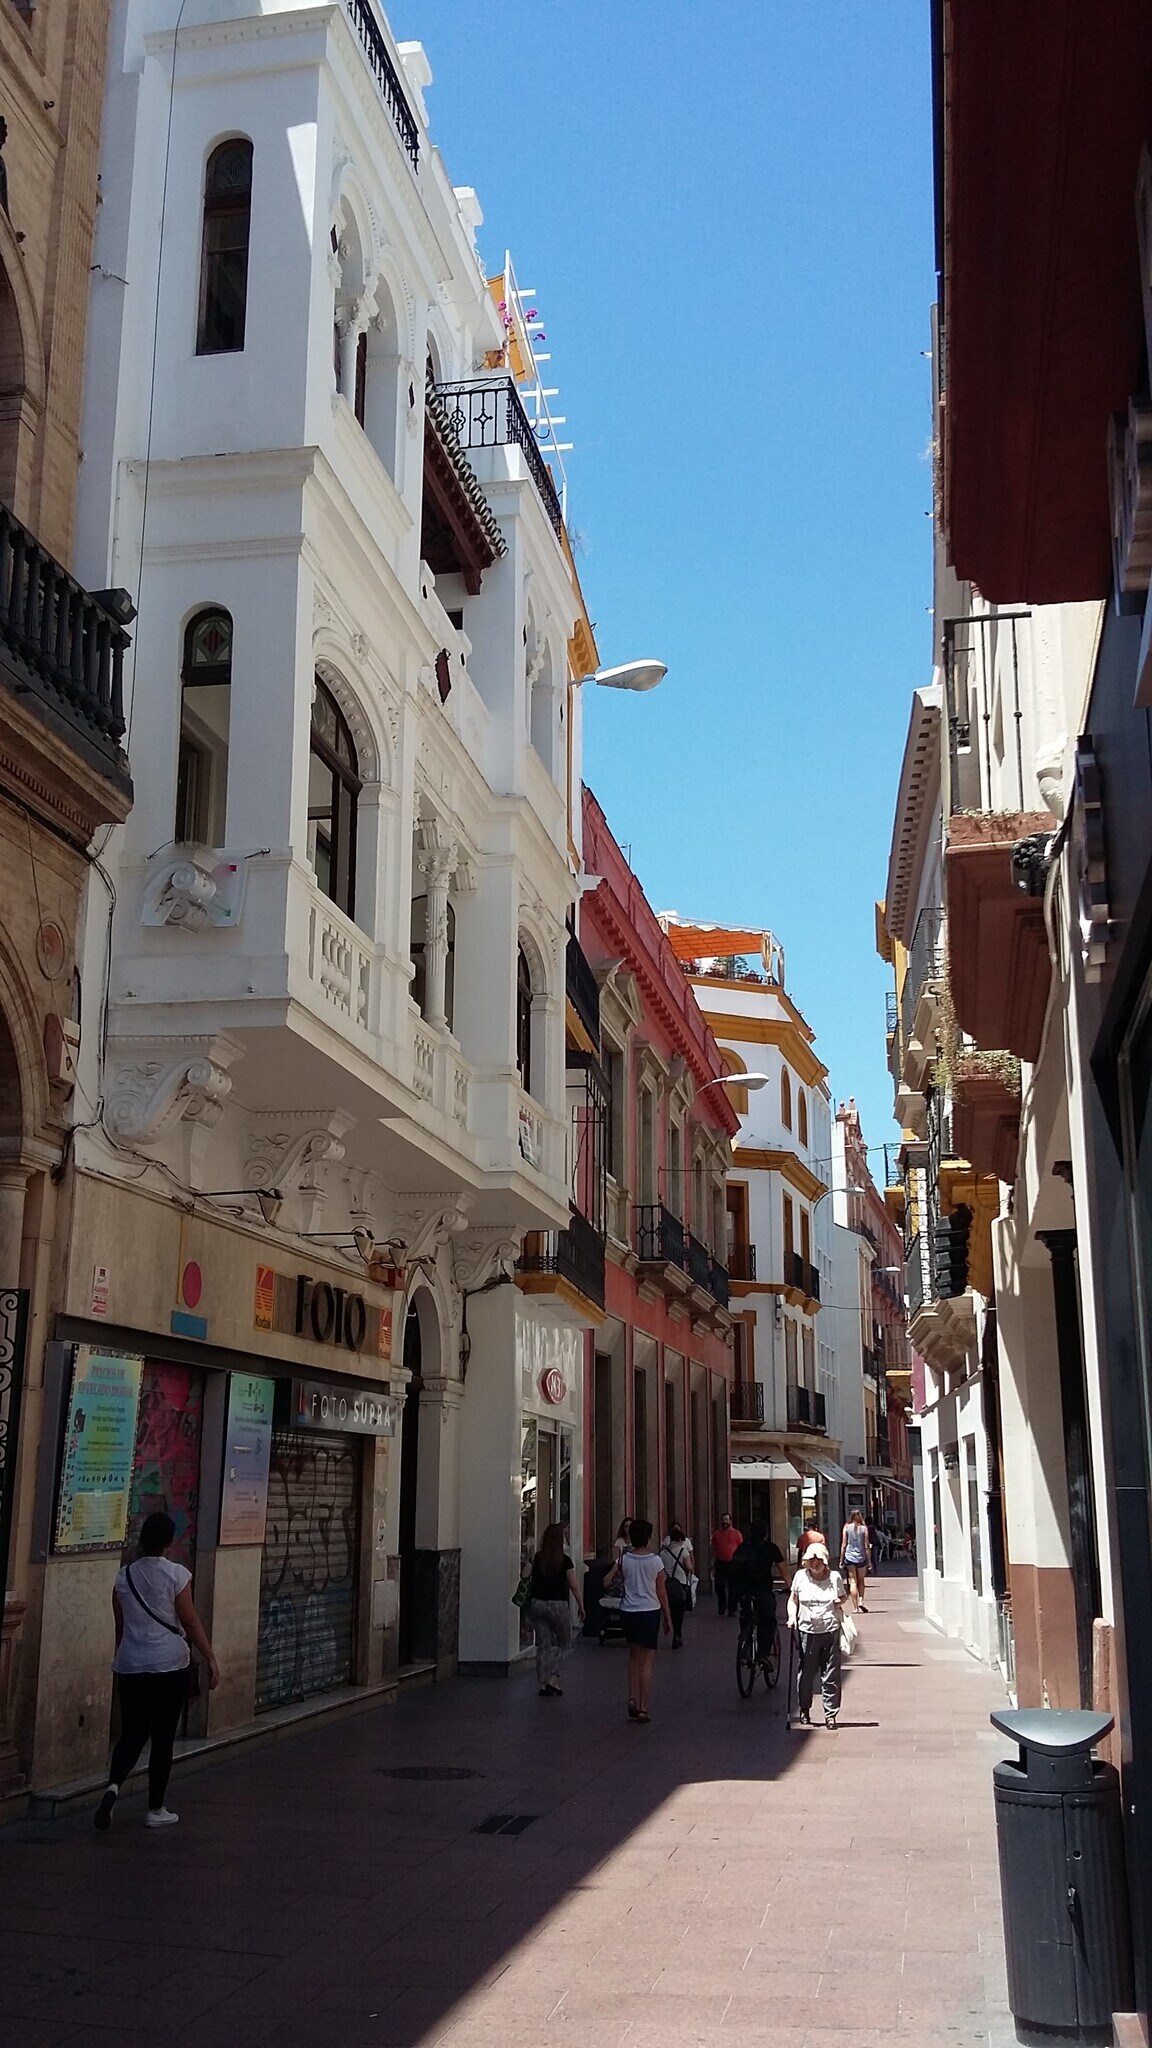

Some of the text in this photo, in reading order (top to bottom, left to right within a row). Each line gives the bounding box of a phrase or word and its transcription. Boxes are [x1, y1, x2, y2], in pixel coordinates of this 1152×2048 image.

[255, 1313, 272, 1330] Kodak
[296, 1274, 366, 1352] FOTO
[311, 1393, 391, 1427] FOTO SUPRA
[730, 1455, 775, 1464] EOX
